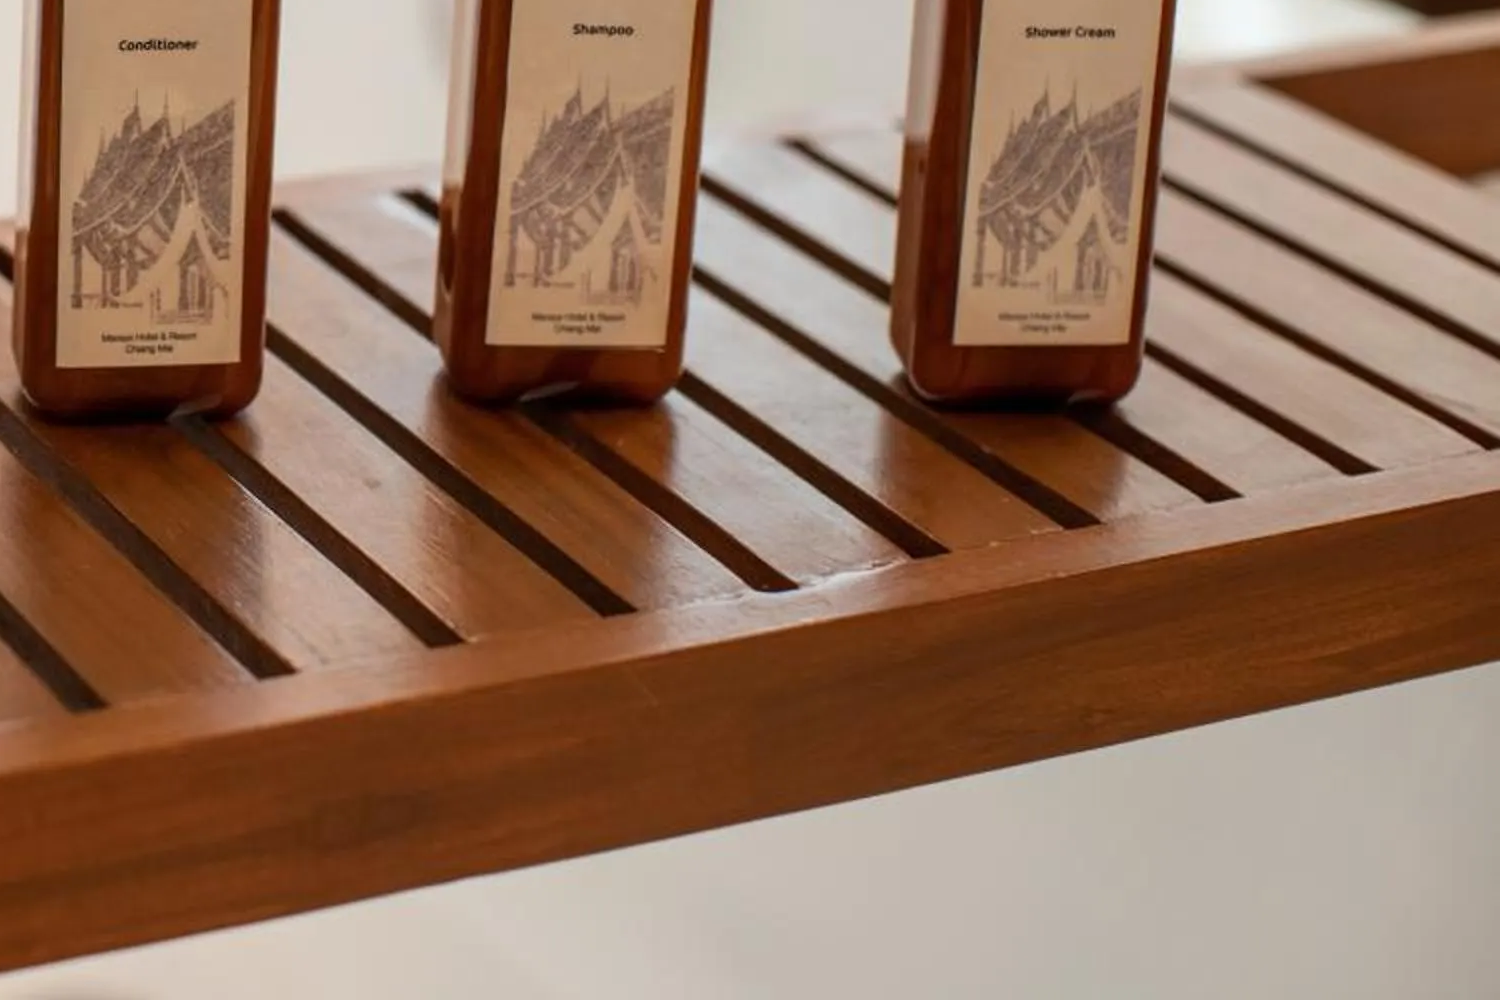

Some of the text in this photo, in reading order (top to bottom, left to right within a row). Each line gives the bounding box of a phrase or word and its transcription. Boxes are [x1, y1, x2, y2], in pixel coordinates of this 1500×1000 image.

[573, 23, 635, 37] Shampoo
[1025, 26, 1116, 39] Shower Cream
[118, 38, 199, 51] Conditioner
